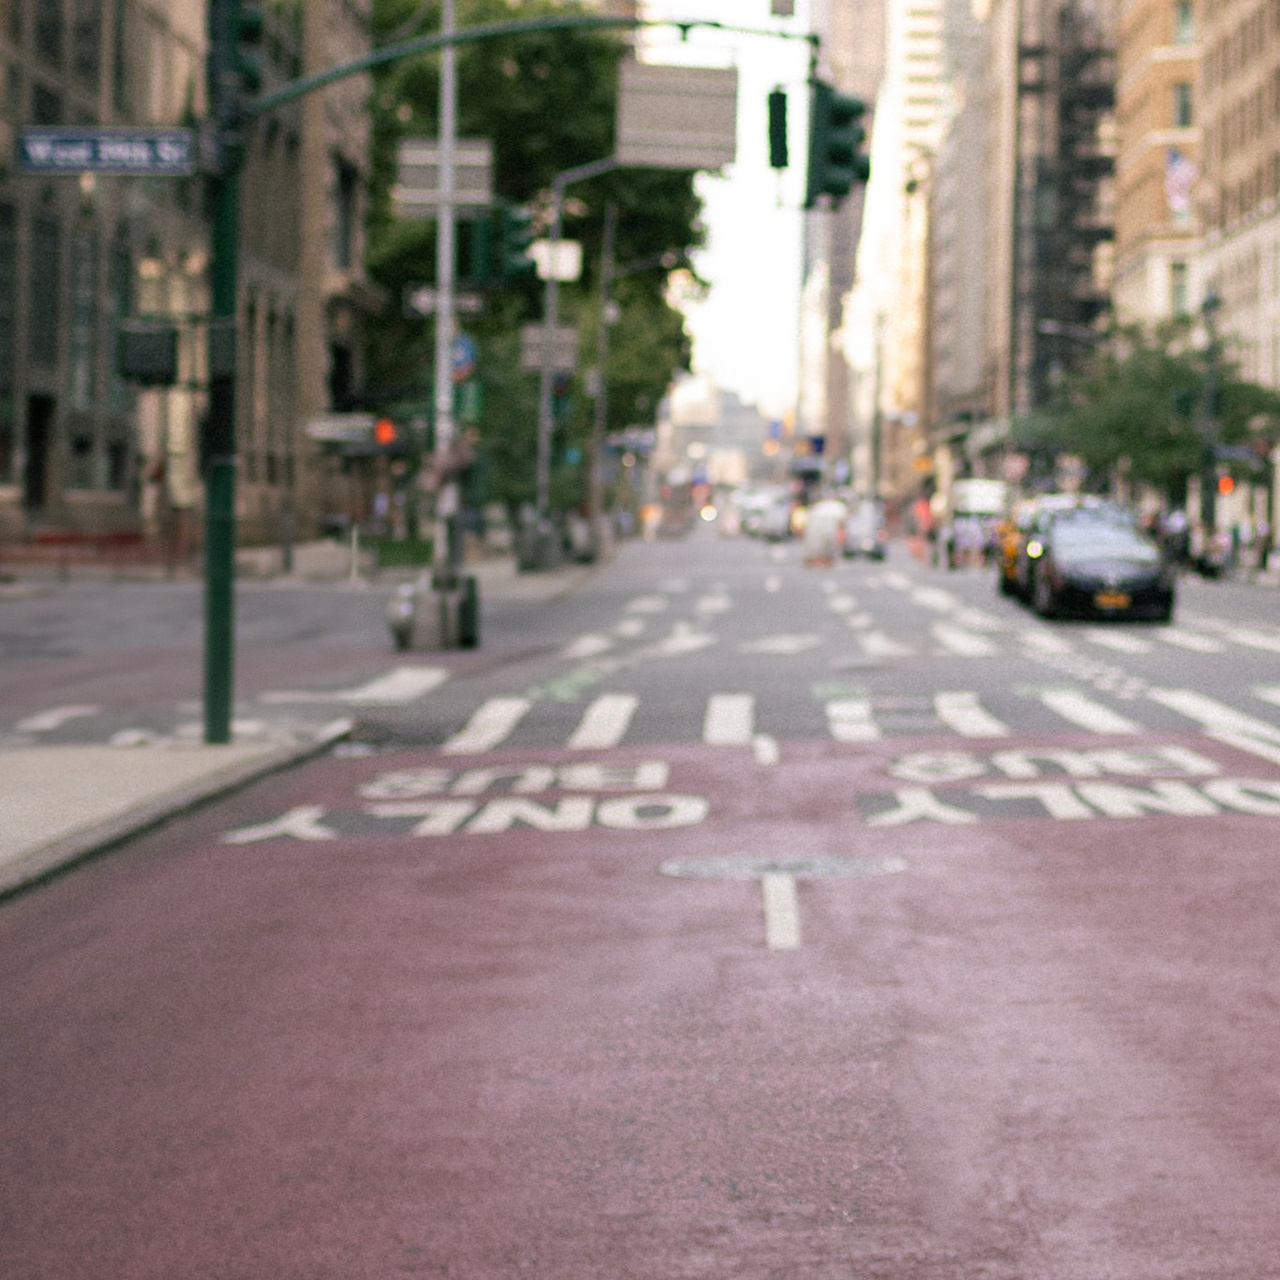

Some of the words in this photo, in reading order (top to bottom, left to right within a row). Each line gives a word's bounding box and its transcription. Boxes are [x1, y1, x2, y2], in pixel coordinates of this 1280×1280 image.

[356, 757, 670, 800] BUS
[889, 743, 1223, 783] BUS
[220, 793, 710, 845] ONLY
